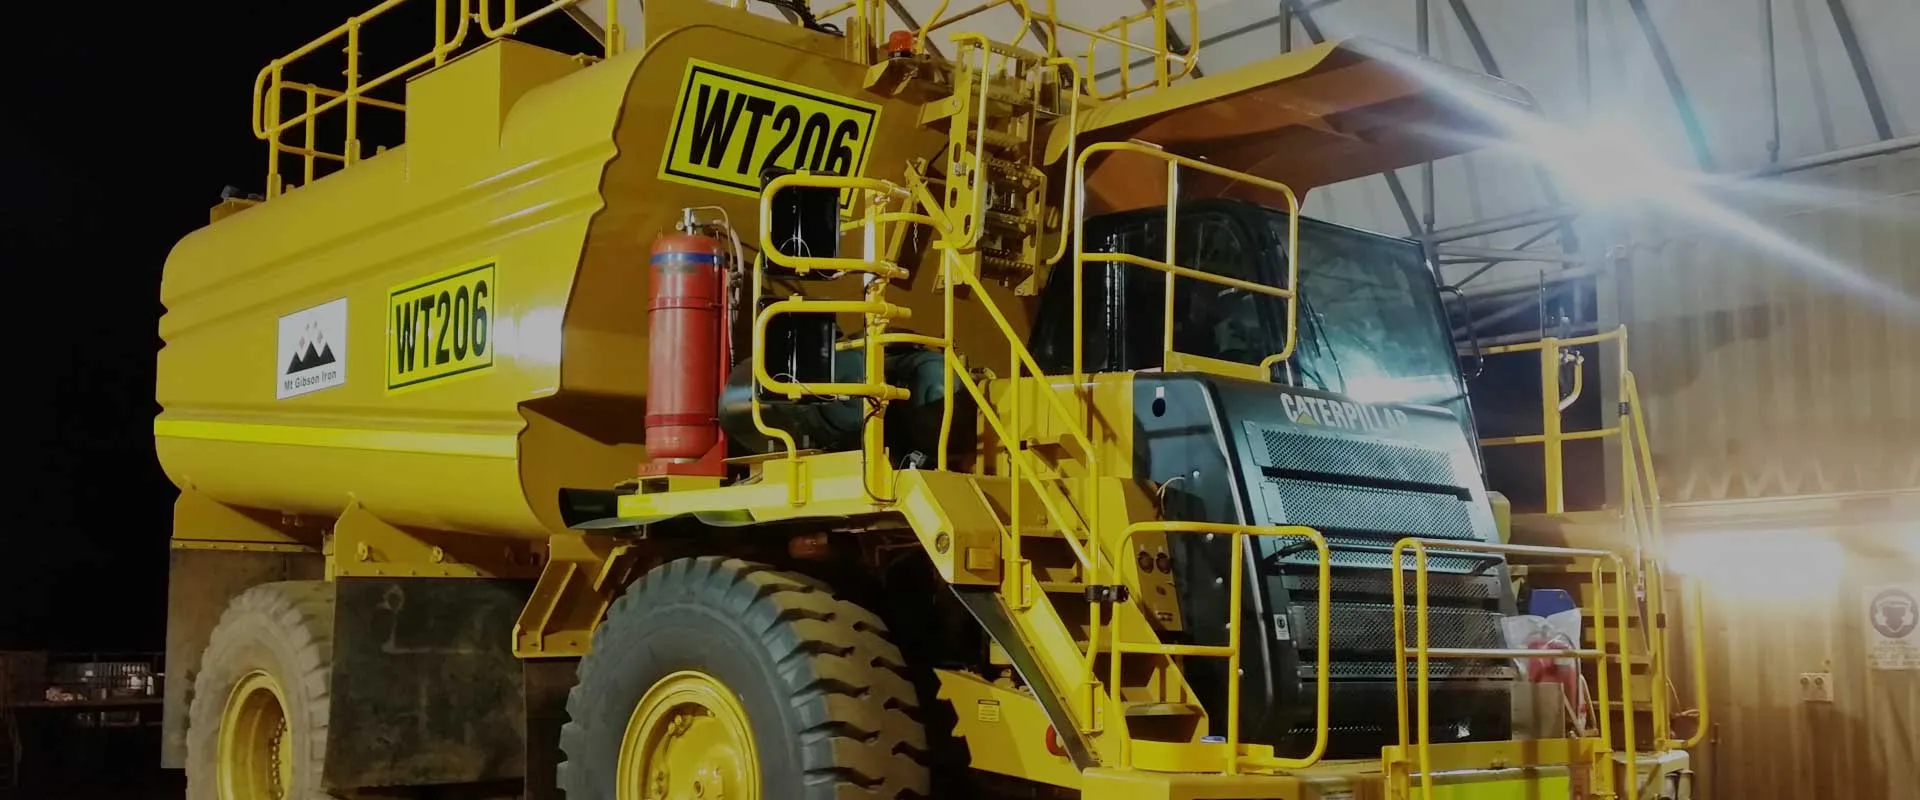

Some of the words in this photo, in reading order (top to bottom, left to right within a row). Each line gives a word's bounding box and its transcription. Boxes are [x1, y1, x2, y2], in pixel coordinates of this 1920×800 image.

[396, 280, 488, 374] WT206
[295, 375, 320, 389] Gibson
[321, 370, 337, 382] Iron
